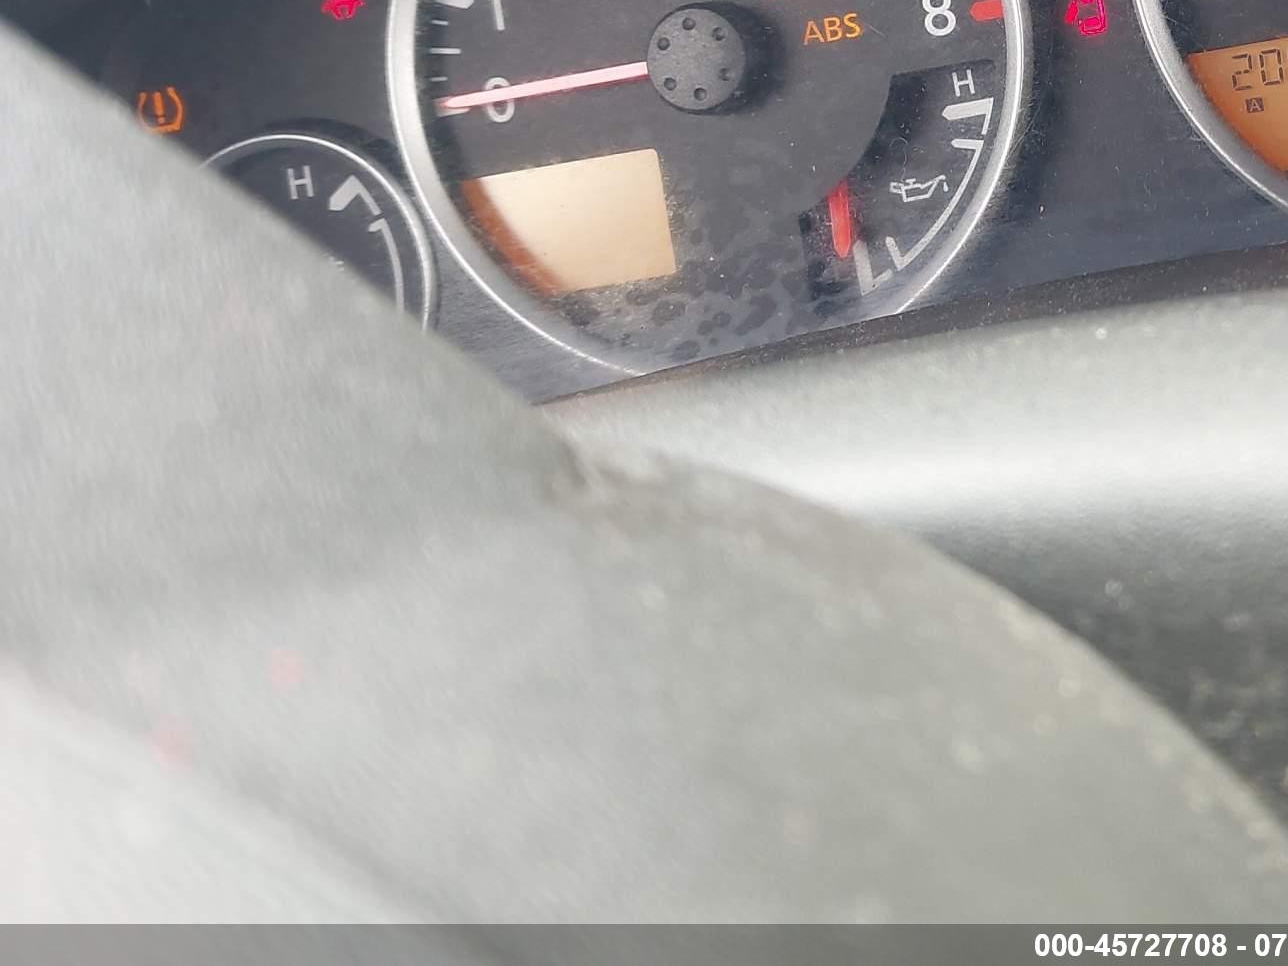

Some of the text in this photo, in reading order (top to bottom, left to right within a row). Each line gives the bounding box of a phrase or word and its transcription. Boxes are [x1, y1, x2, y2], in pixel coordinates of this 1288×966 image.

[803, 12, 863, 47] ABS
[483, 76, 516, 124] 0
[951, 68, 976, 97] H
[286, 165, 315, 201] H
